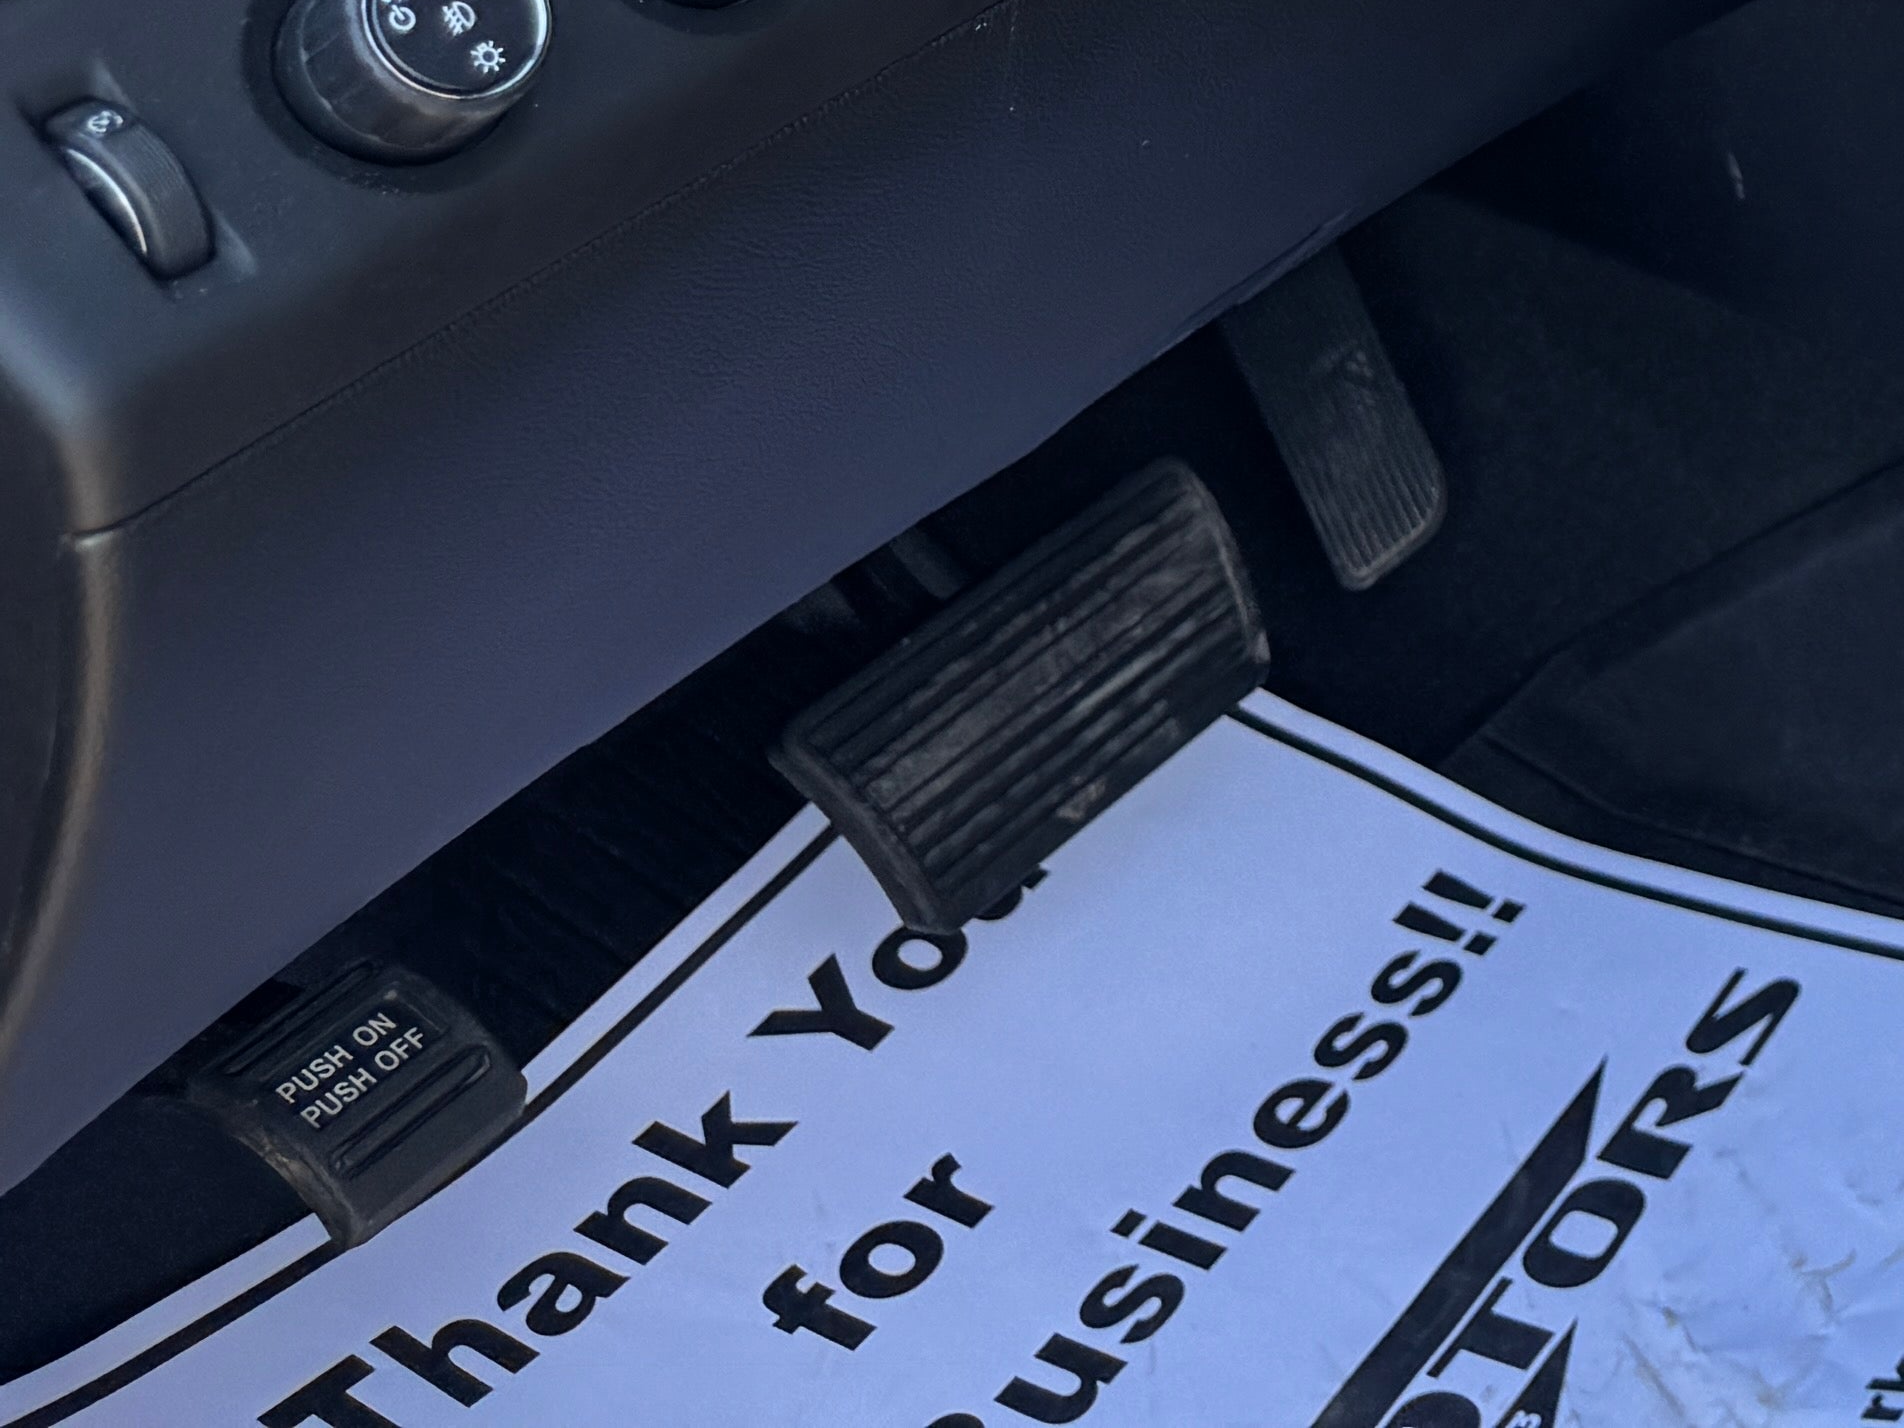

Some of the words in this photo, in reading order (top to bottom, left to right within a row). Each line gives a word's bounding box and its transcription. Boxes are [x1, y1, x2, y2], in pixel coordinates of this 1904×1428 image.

[275, 1045, 353, 1104] PUSH
[352, 1012, 397, 1048] ON
[300, 1068, 377, 1129] PUSH
[374, 1026, 426, 1072] OFF
[924, 869, 1527, 1428] usiness!!
[256, 1089, 799, 1428] Thank
[760, 1152, 994, 1353] for
